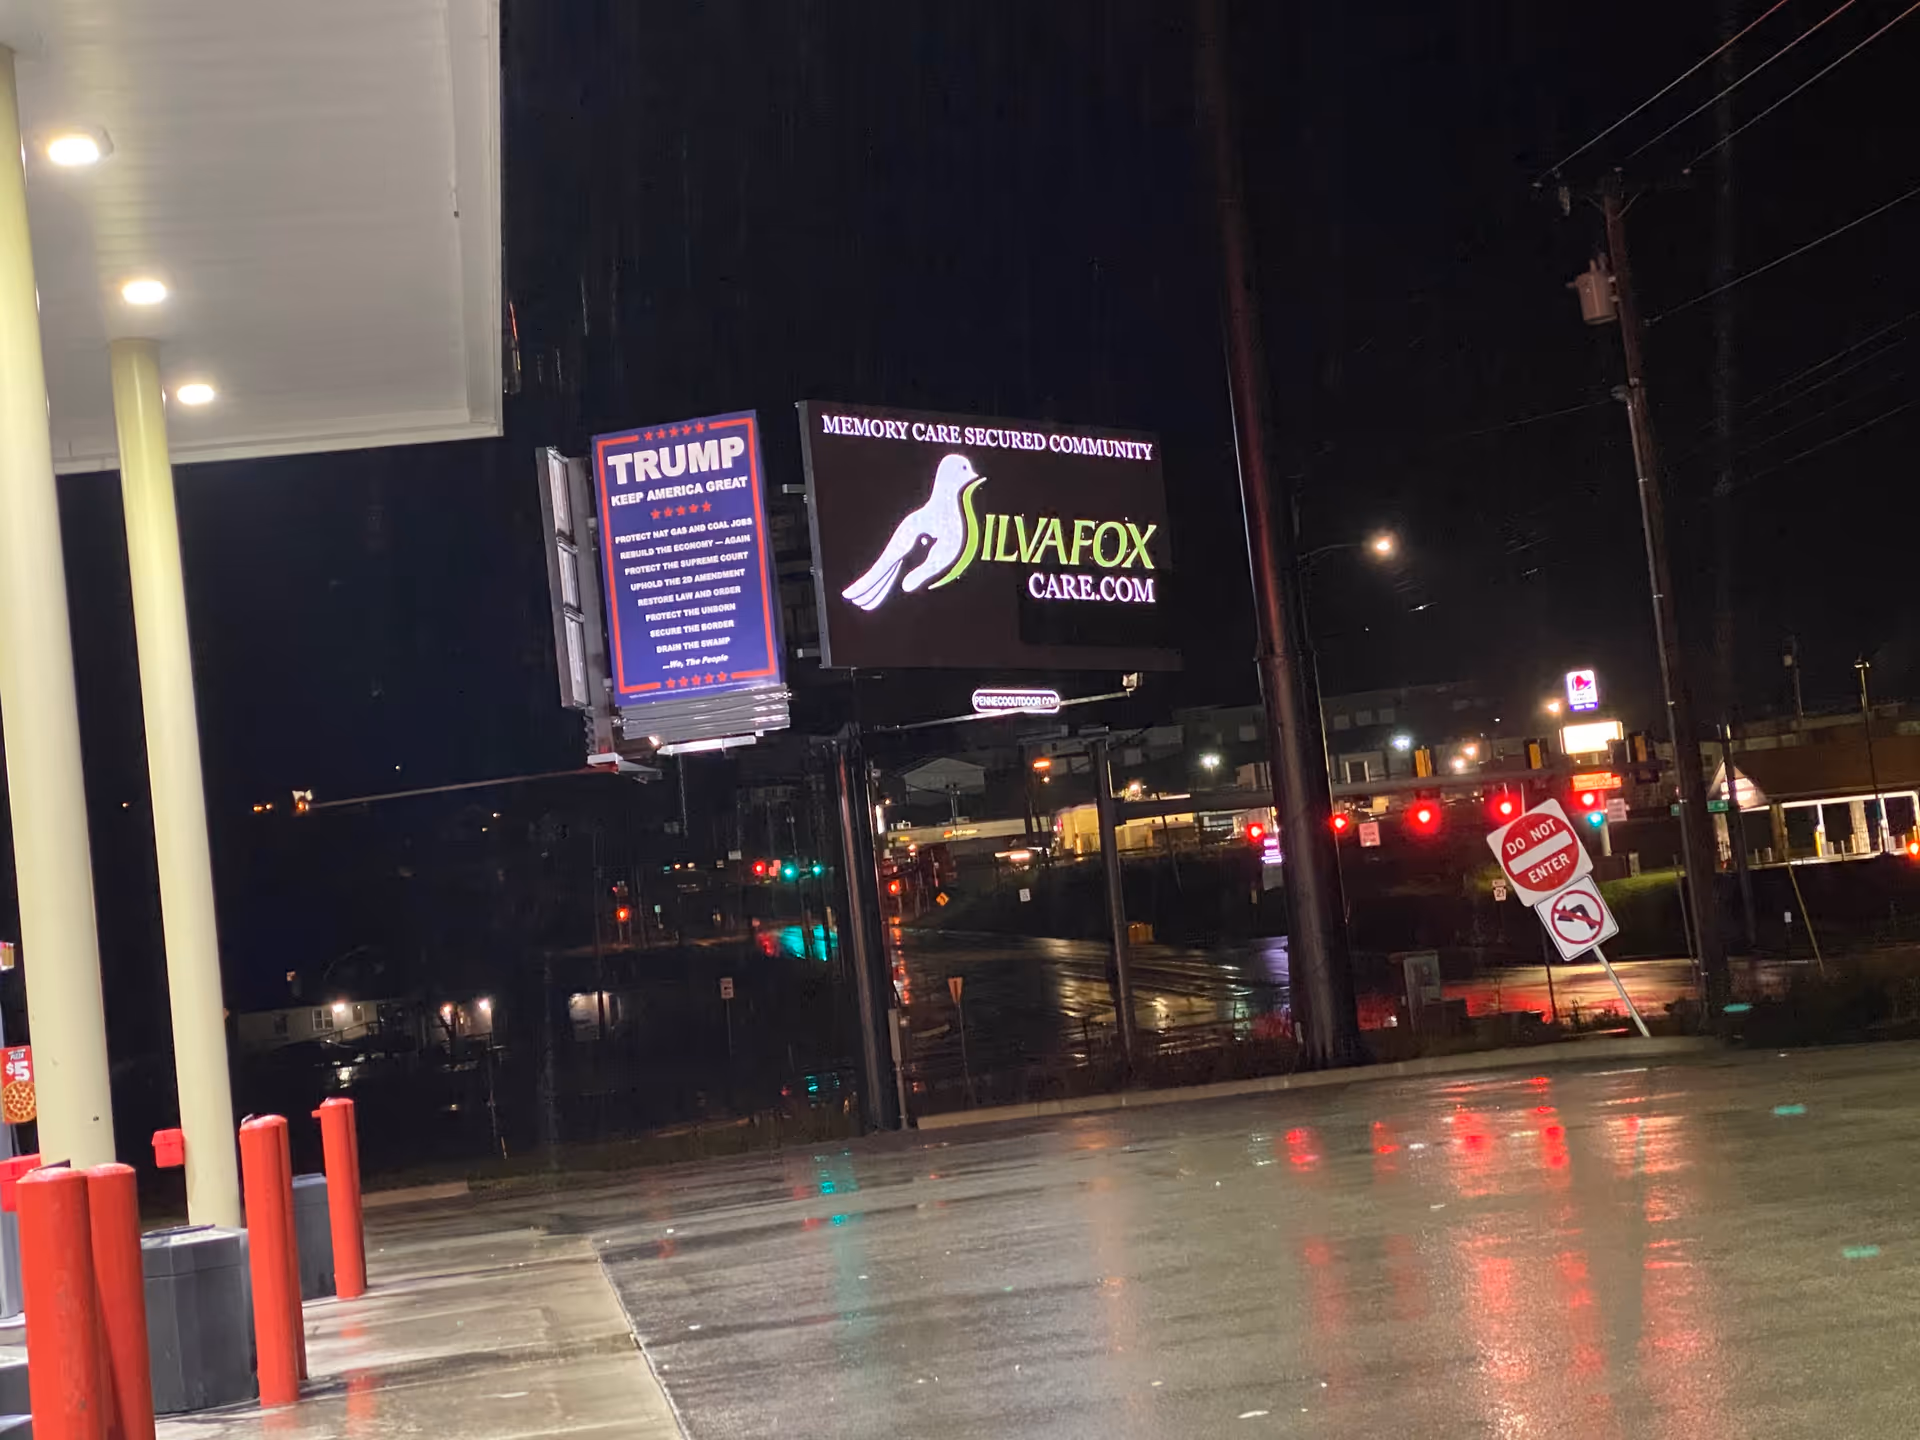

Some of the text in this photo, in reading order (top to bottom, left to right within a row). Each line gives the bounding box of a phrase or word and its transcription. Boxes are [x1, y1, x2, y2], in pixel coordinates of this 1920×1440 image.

[822, 415, 1152, 460] MEMORY CARE SECURED COMMUNITY
[608, 437, 744, 484] TRUMP
[611, 476, 747, 506] KEEP AMERICA GREAT
[615, 518, 752, 544] PROTECT NAT GAS AND COAL JOBS
[620, 548, 655, 559] REBUILD
[655, 546, 672, 554] THE
[674, 540, 713, 551] ECONOMY
[725, 535, 750, 544] AGAIN
[625, 551, 748, 575] PROTECT THE SUPREME COURT
[631, 569, 745, 591] UPHOLD THE 2D AMENDMENT
[1029, 573, 1155, 602] CARE.COM
[638, 586, 741, 606] RESTORE LAW AND ORDER
[646, 603, 736, 622] PROTECT THE UNBORN
[650, 620, 734, 637] SECURE THE BORDER
[656, 637, 730, 653] DRAIN THE SWAMP
[686, 658, 701, 666] The
[702, 654, 728, 664] People
[1505, 818, 1557, 855] DO NOT
[1528, 853, 1570, 884] ENTER
[6, 1061, 30, 1081] $5
